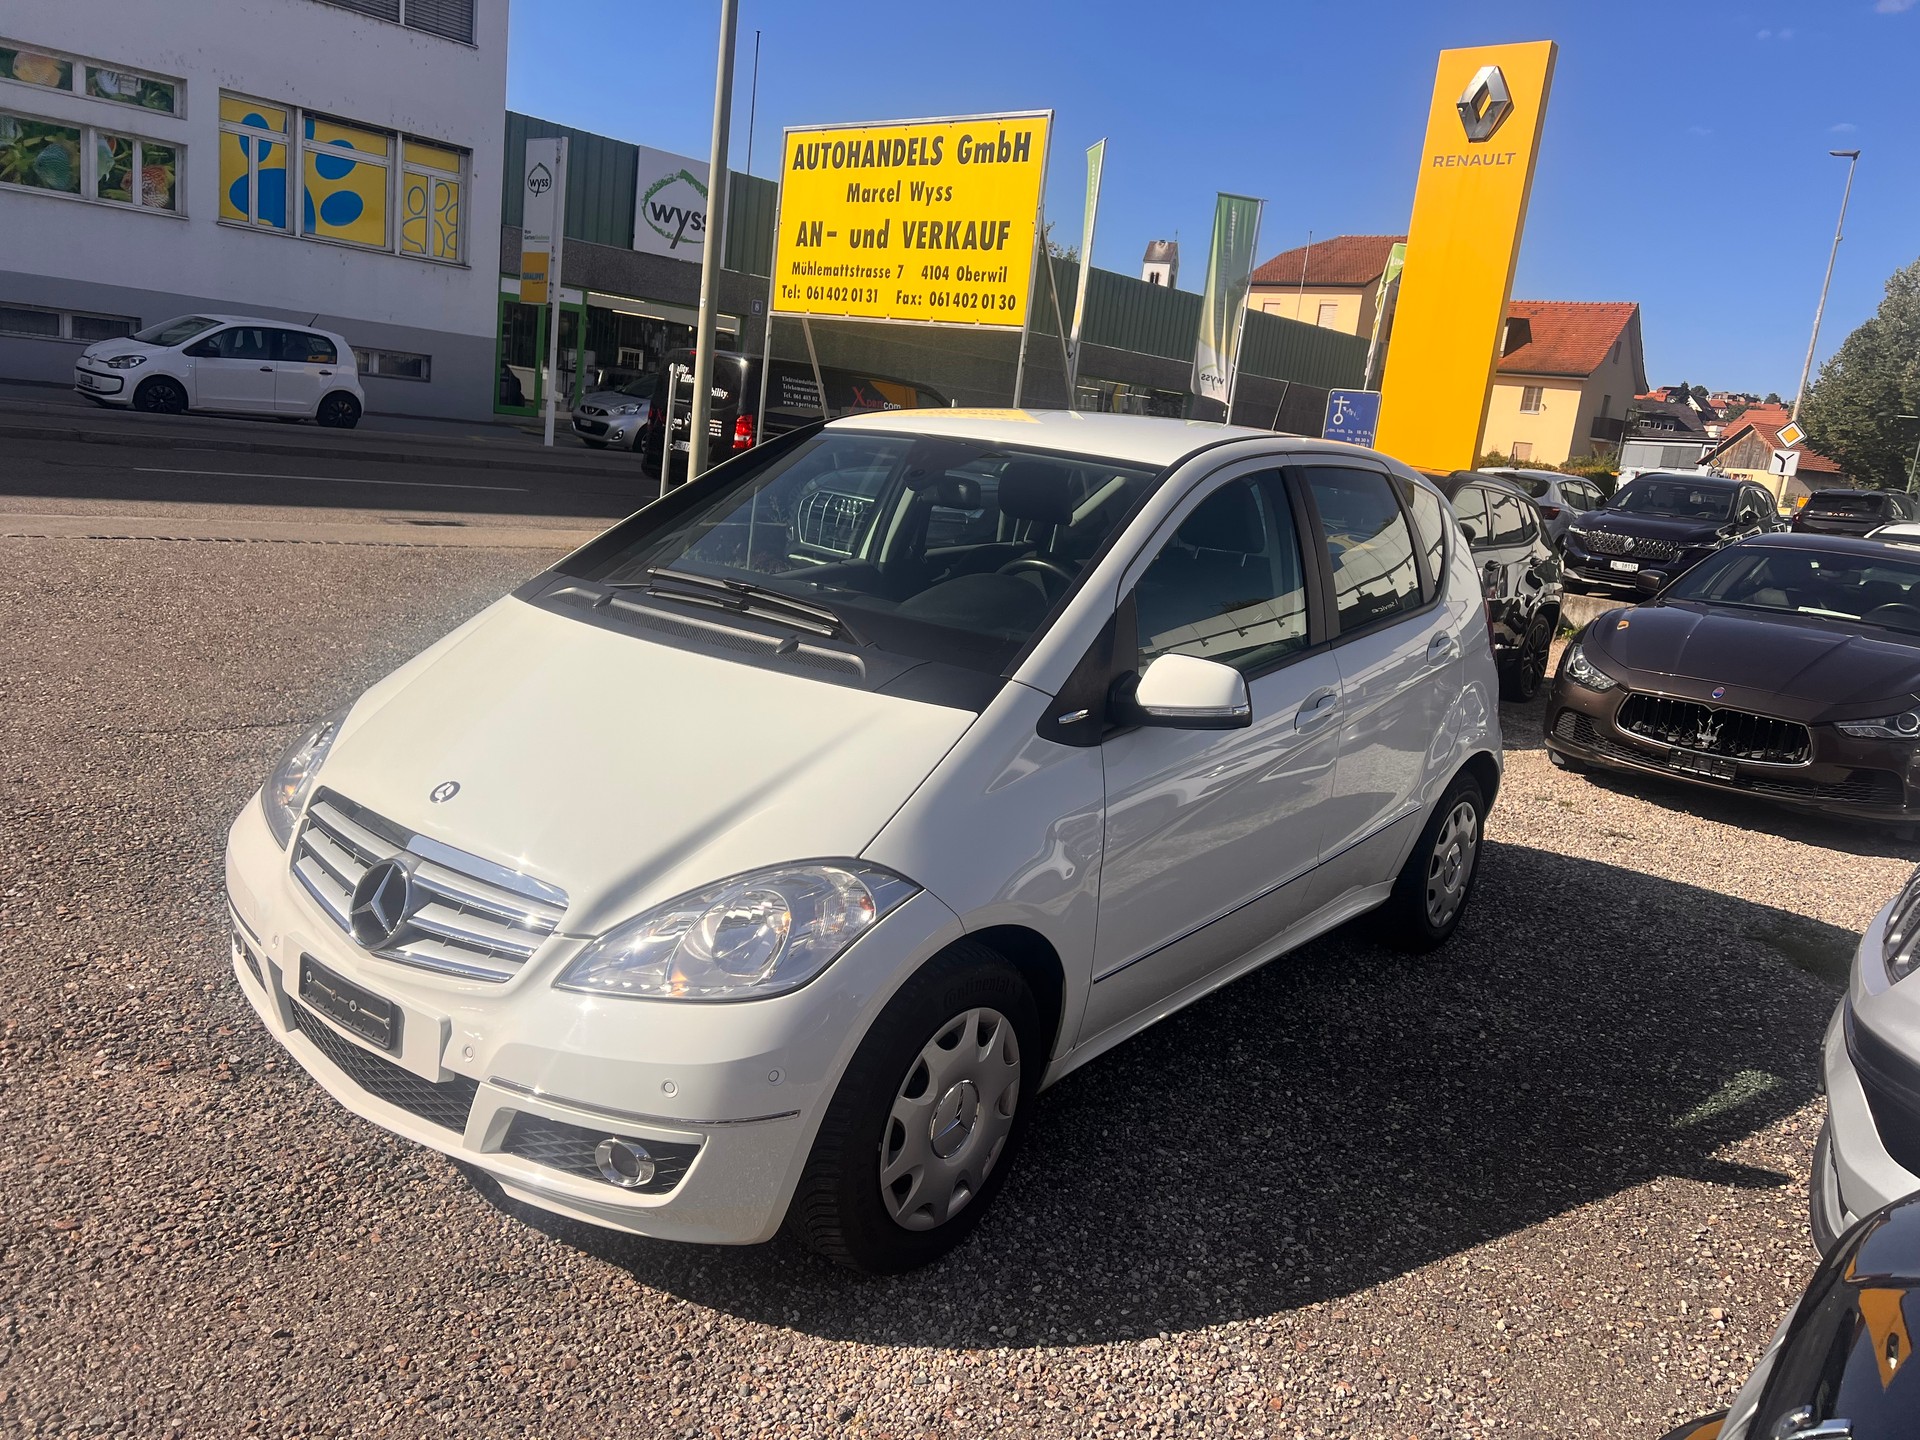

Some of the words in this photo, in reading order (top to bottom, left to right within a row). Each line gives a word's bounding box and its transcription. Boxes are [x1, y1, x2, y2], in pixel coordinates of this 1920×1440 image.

[792, 135, 944, 170] AUTOHANDELS
[957, 130, 1032, 165] GmbH
[1433, 153, 1516, 167] RENAULT
[529, 178, 549, 197] wyss
[846, 180, 902, 203] Marcel
[909, 181, 953, 206] Wyss
[849, 218, 890, 249] und
[902, 220, 1011, 251] VERKAUF
[791, 261, 891, 279] Mühlemattstrasse
[896, 264, 904, 279] 7
[921, 265, 950, 281] 4104
[956, 266, 1008, 283] Oberwil
[782, 284, 801, 299] Tel:
[896, 290, 922, 306] Fax:
